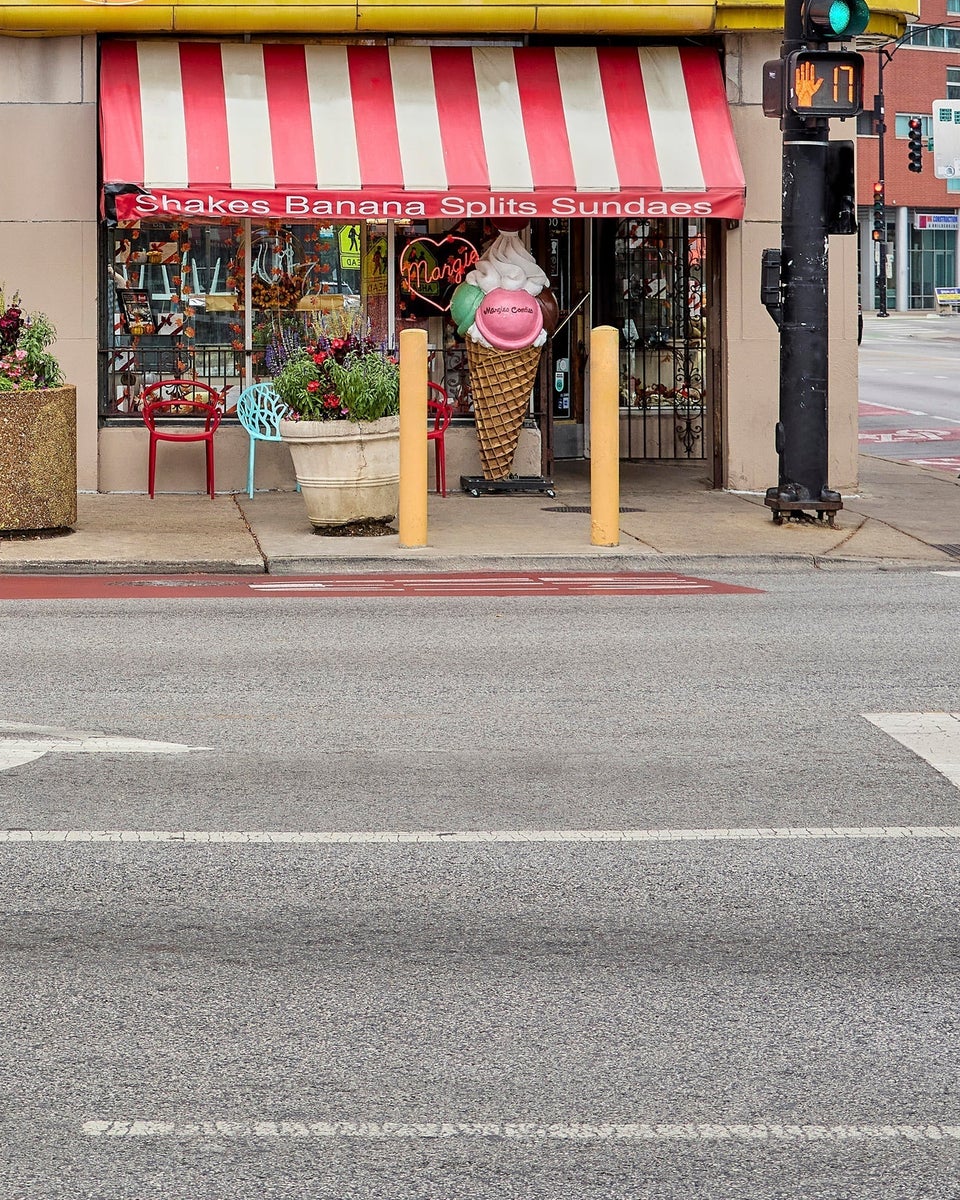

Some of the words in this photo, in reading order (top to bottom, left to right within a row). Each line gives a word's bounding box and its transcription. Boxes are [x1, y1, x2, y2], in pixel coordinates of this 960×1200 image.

[135, 194, 271, 214] Shakes
[285, 195, 426, 216] Banana
[440, 196, 538, 218] Splits
[551, 197, 713, 216] Sundaes
[402, 246, 480, 292] Margie
